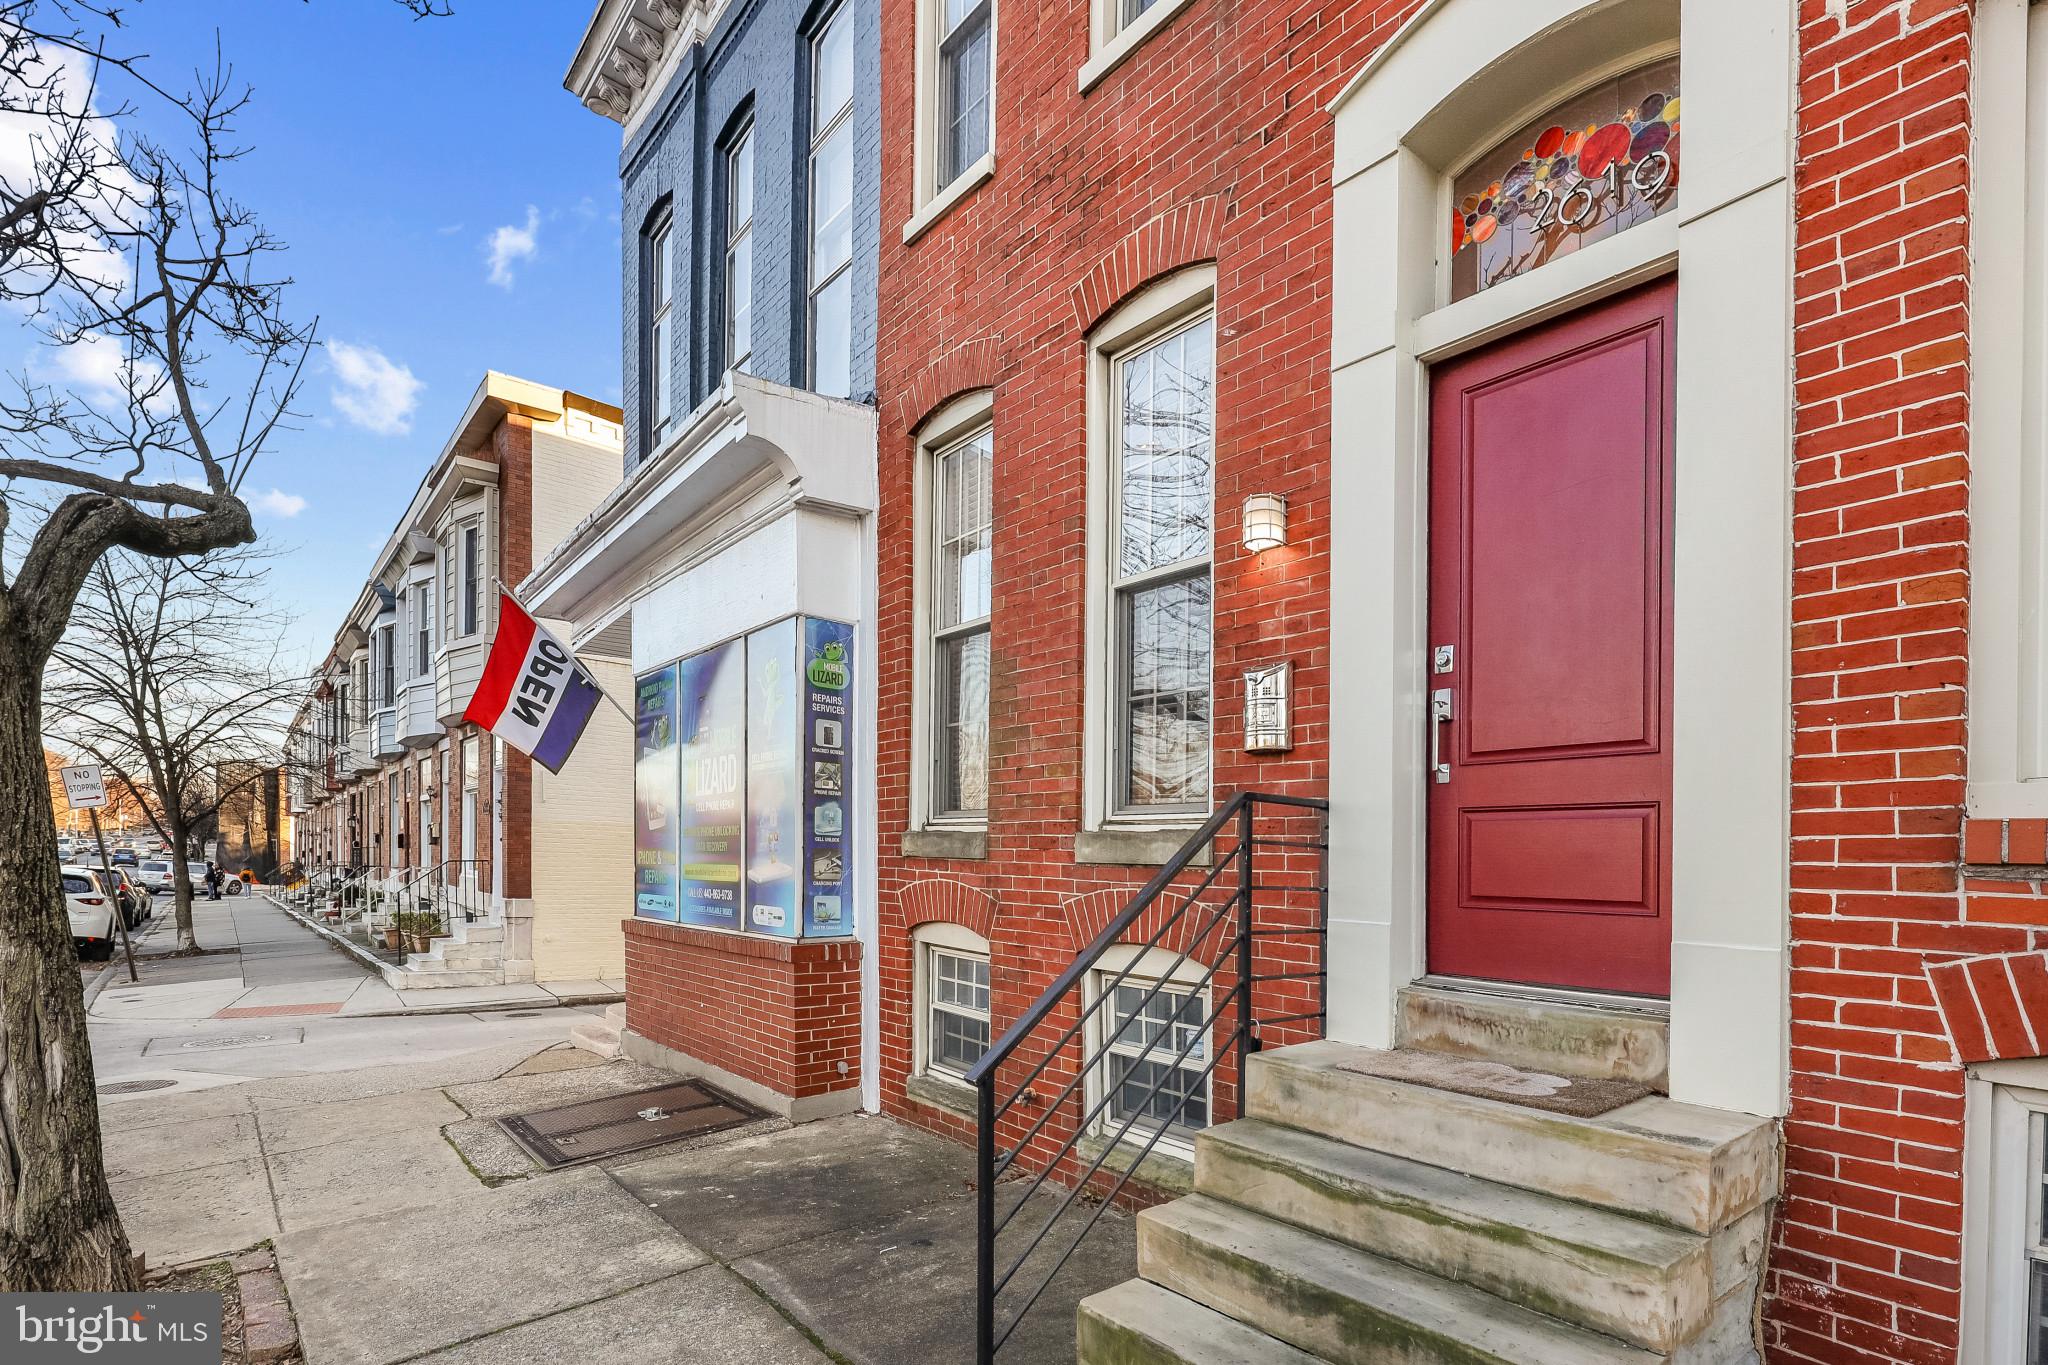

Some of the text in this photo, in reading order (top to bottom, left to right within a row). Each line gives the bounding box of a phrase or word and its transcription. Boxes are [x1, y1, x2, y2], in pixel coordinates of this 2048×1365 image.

[1530, 150, 1671, 234] 2619
[824, 661, 843, 673] MOBILE
[812, 669, 844, 686] LIZARD
[812, 693, 843, 705] REPAIRS
[812, 702, 845, 715] SERVICES
[73, 770, 90, 780] NO
[695, 753, 737, 796] LIZARD
[68, 782, 101, 793] STOPPING
[688, 887, 697, 898] CALL
